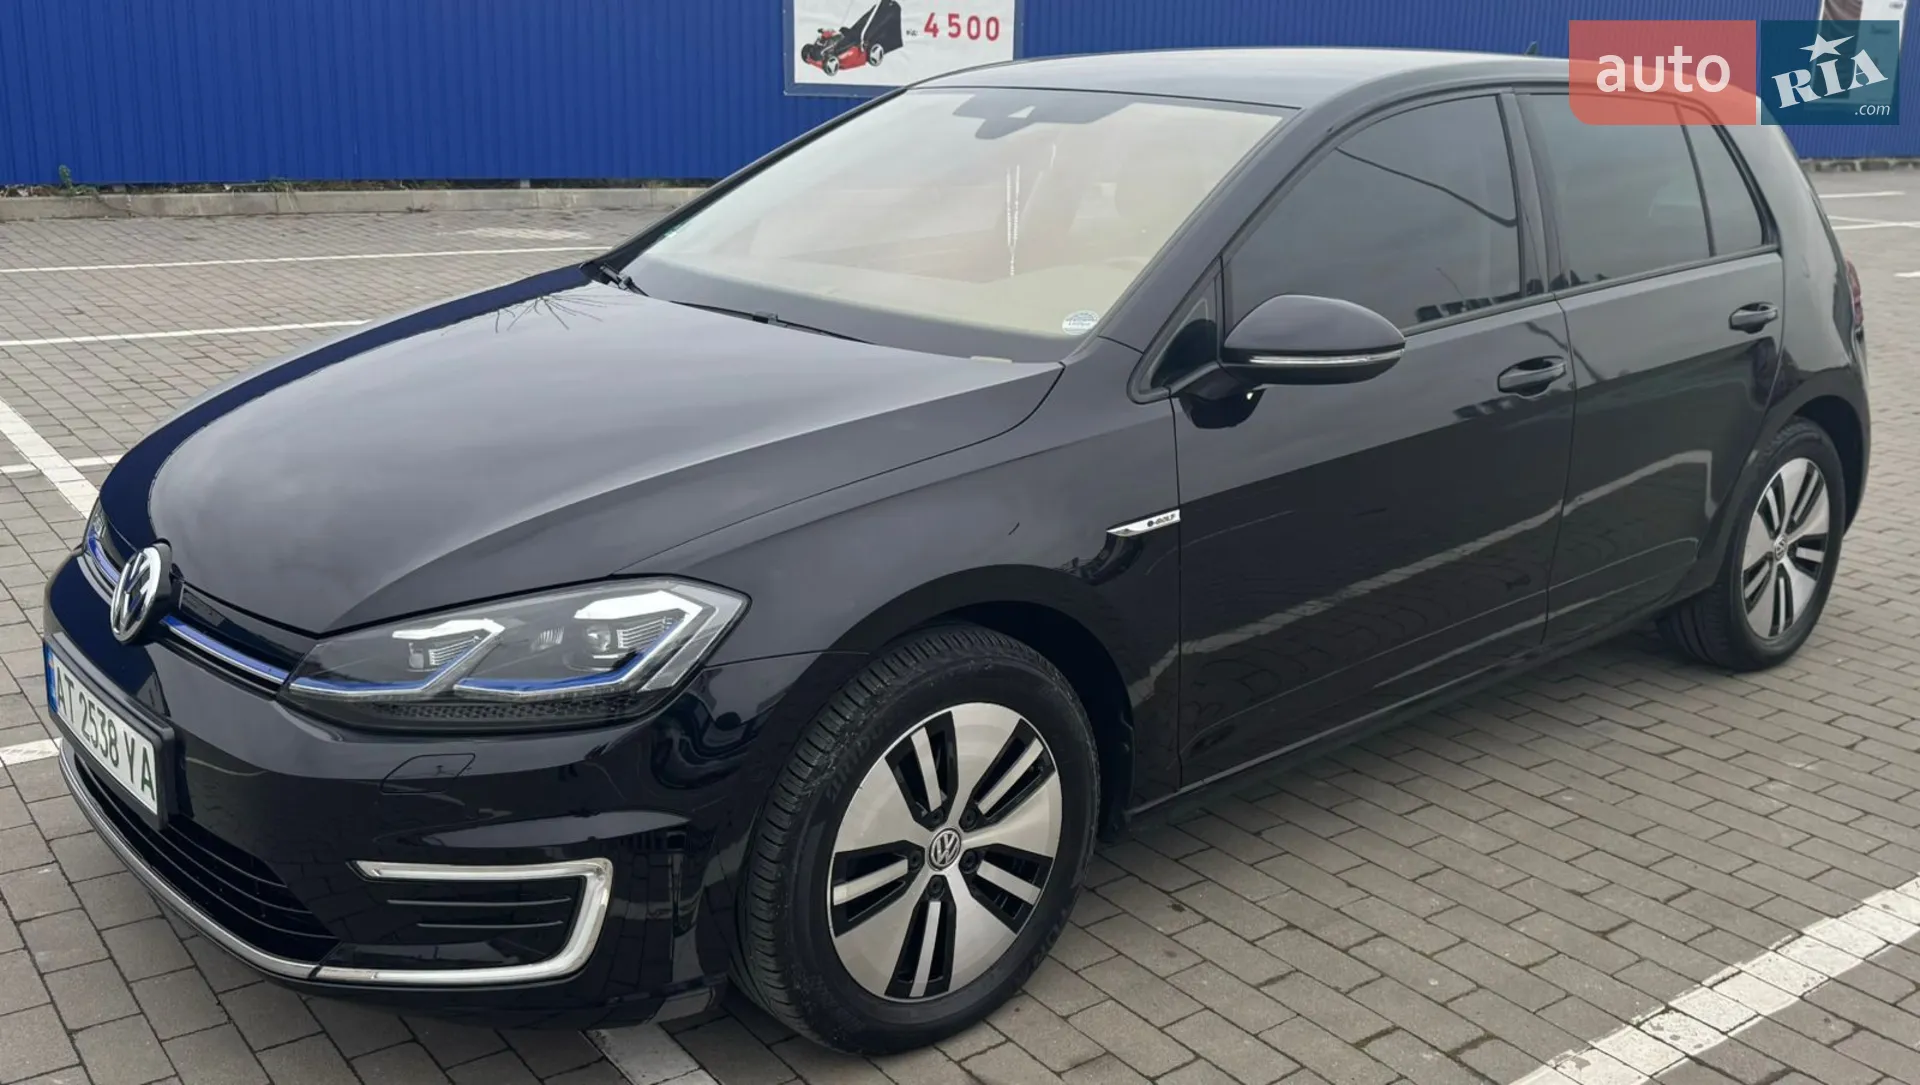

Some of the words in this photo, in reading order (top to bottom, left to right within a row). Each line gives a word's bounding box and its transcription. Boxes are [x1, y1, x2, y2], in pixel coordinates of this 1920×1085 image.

[57, 667, 75, 725] AT
[78, 691, 120, 768] 2538
[123, 730, 156, 802] YA
